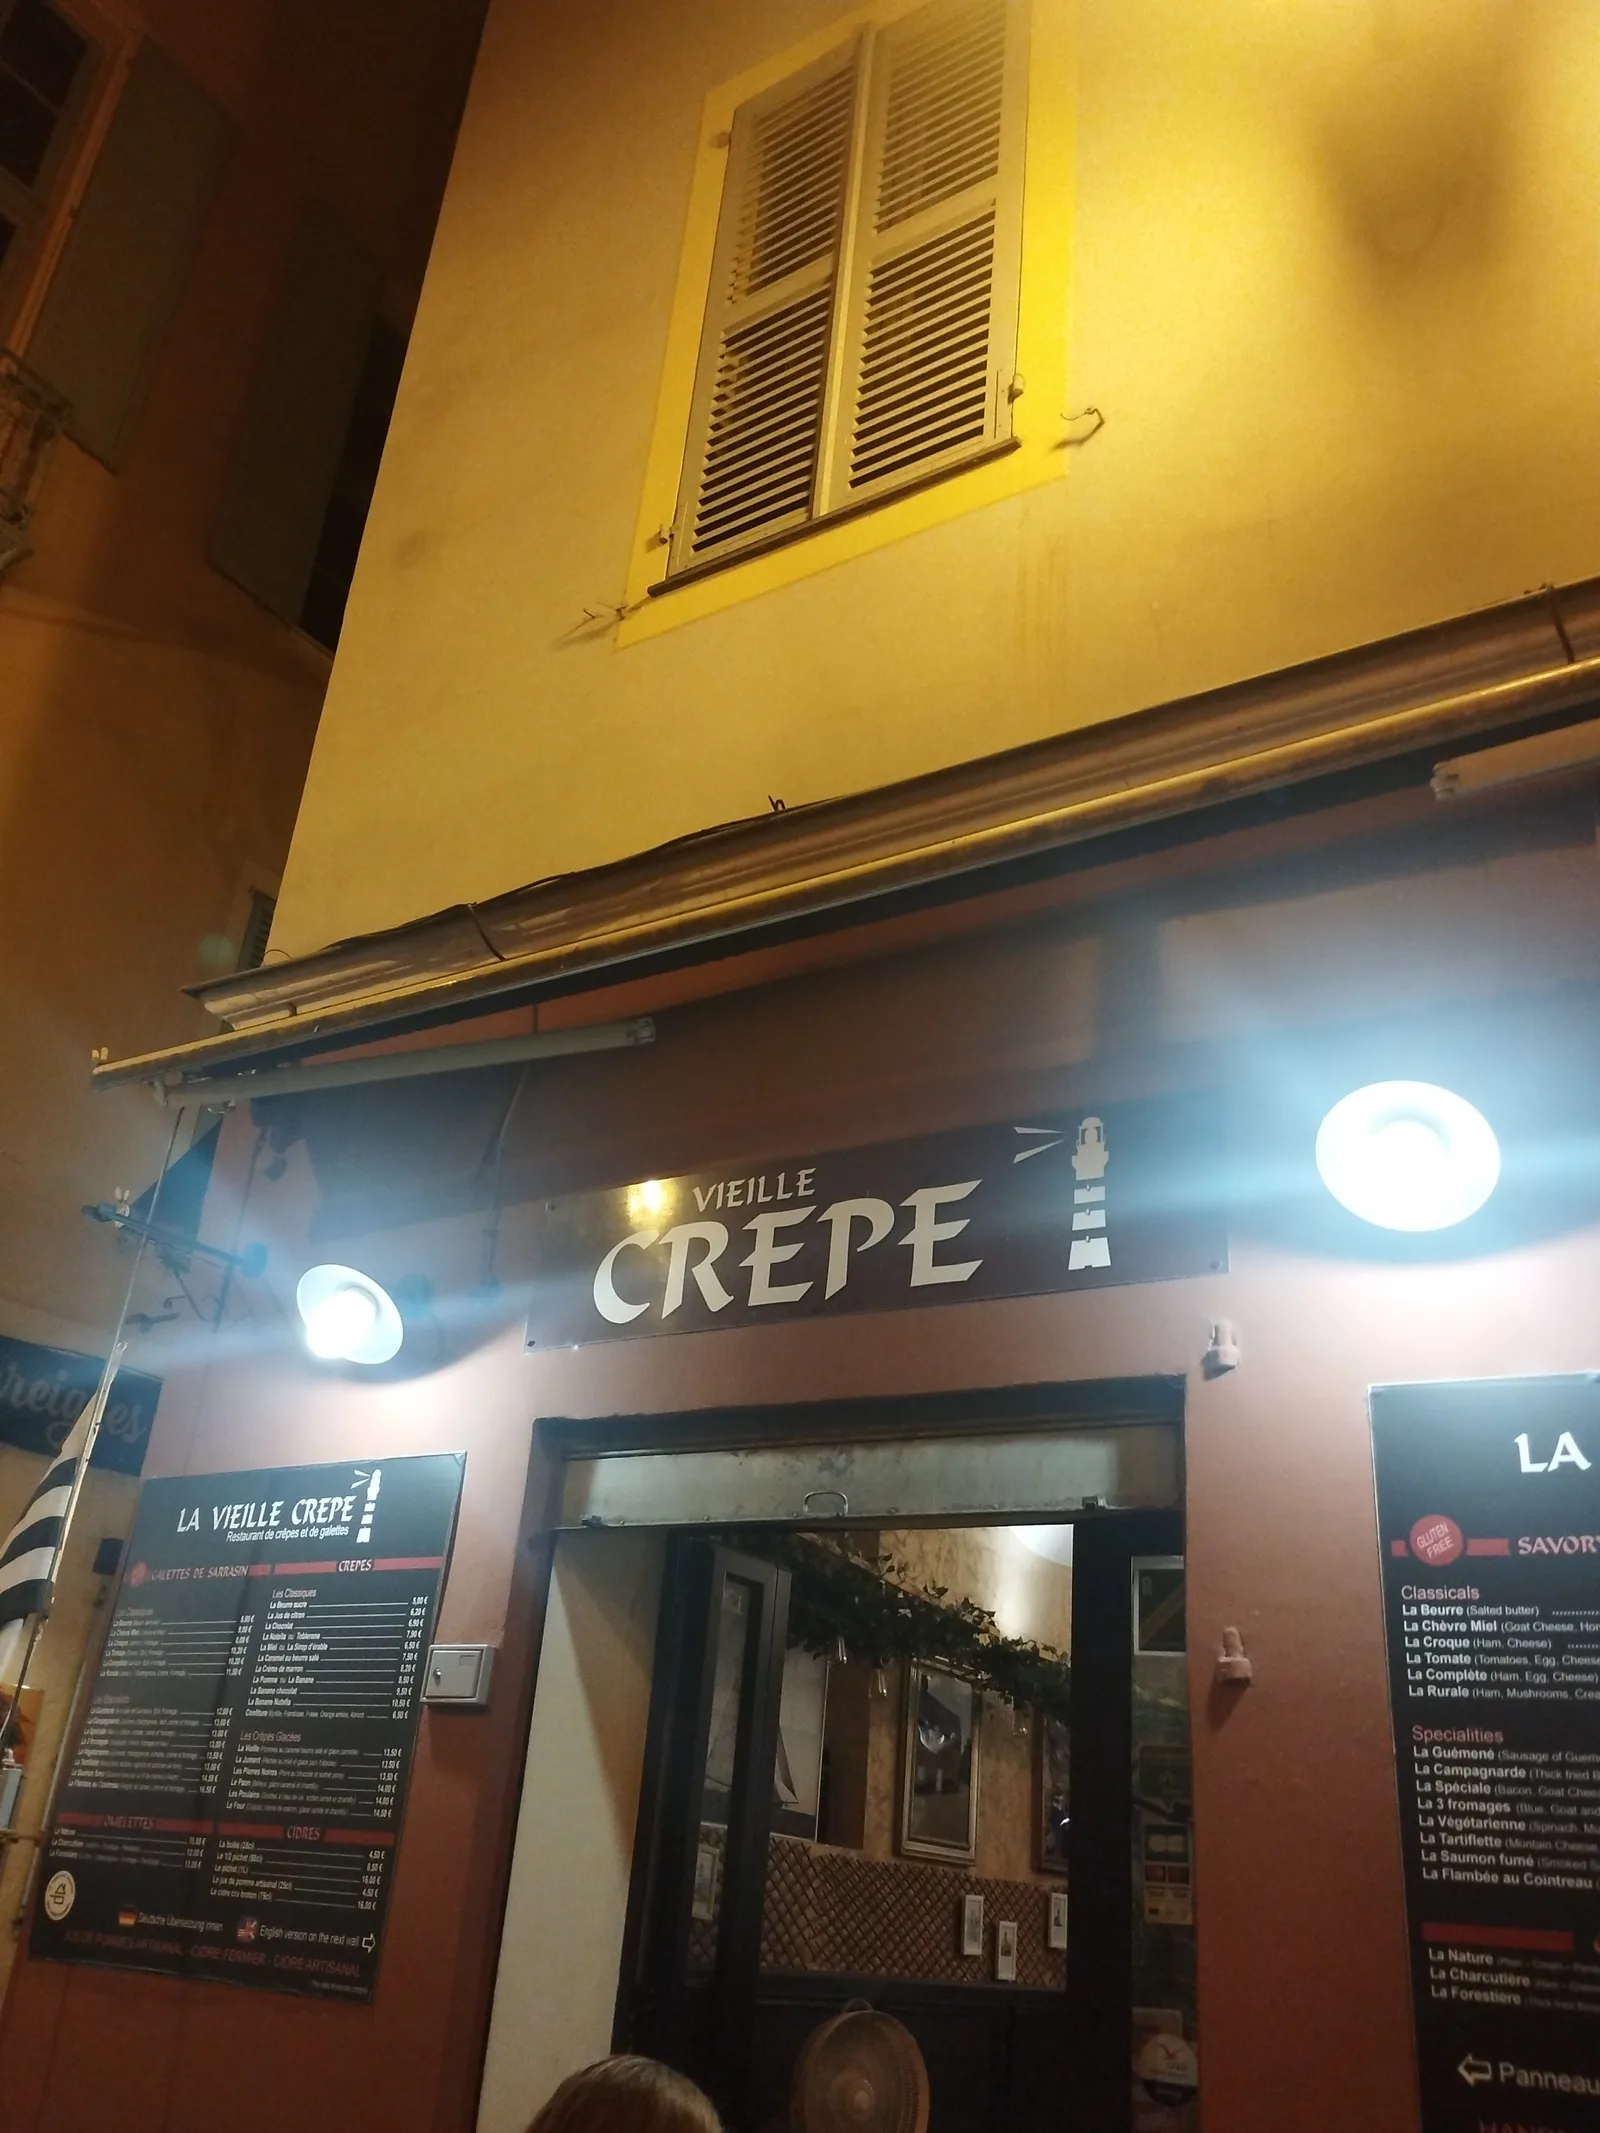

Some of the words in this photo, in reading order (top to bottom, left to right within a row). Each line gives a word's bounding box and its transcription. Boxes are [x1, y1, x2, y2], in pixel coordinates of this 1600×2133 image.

[693, 1168, 816, 1212] VIEILLE
[592, 1179, 984, 1325] CREPE
[1514, 1431, 1592, 1473] LA
[176, 1506, 200, 1533] LA
[212, 1500, 284, 1531] VIEILLE
[291, 1495, 357, 1525] CREPE
[226, 1530, 263, 1543] Restaurant
[264, 1529, 274, 1540] de
[275, 1528, 299, 1541] crêpes
[300, 1527, 308, 1538] et
[308, 1526, 318, 1537] de
[319, 1524, 349, 1539] galettes
[1416, 1521, 1449, 1549] GLUTEN
[1426, 1536, 1454, 1559] FREE
[151, 1567, 191, 1581] GALETTES
[192, 1567, 205, 1579] DE
[207, 1564, 250, 1578] SARRASIN
[338, 1558, 373, 1573] CREPES
[272, 1589, 283, 1599] Les
[284, 1588, 317, 1599] Classiques
[1401, 1585, 1480, 1601] Classicals
[270, 1601, 276, 1609] La
[1402, 1604, 1417, 1616] La
[1466, 1605, 1502, 1617] (Salted
[1505, 1605, 1540, 1617] butter)
[1403, 1620, 1419, 1632] La
[1470, 1620, 1498, 1632] Miel
[1500, 1621, 1531, 1633] (Goat
[1404, 1636, 1420, 1648] La
[1423, 1636, 1470, 1650] Croque
[1472, 1638, 1504, 1650] (Ham,
[1507, 1638, 1552, 1650] Cheese)
[1406, 1652, 1421, 1664] La
[1424, 1652, 1471, 1665] Tomate
[1407, 1668, 1422, 1680] La
[1408, 1684, 1424, 1697] La
[1427, 1684, 1470, 1697] Rurale
[240, 1730, 251, 1741] Les
[1412, 1725, 1504, 1744] Specialities
[1413, 1745, 1429, 1758] La
[1414, 1762, 1430, 1775] La
[1433, 1763, 1526, 1780] Campagnarde
[1416, 1780, 1432, 1792] La
[1435, 1780, 1491, 1795] Spéciale
[1417, 1797, 1433, 1810] La
[1436, 1797, 1444, 1810] 3
[1447, 1798, 1511, 1815] fromages
[1418, 1814, 1434, 1827] La
[286, 1825, 321, 1841] CIDRES
[1420, 1832, 1435, 1844] La
[1438, 1832, 1501, 1847] Tartiflette
[1421, 1849, 1436, 1862] La
[1440, 1850, 1496, 1864] Saumon
[1499, 1853, 1534, 1867] fumé
[1422, 1867, 1438, 1880] La
[1442, 1867, 1499, 1883] Flambée
[1503, 1874, 1519, 1885] au
[1523, 1872, 1592, 1889] Cointreau
[260, 1925, 283, 1940] English
[284, 1929, 307, 1941] version
[308, 1932, 317, 1942] on
[318, 1932, 329, 1944] the
[329, 1934, 345, 1945] next
[346, 1935, 360, 1947] wall
[1429, 1947, 1445, 1961] La
[1448, 1948, 1493, 1964] Nature
[1430, 1966, 1446, 1979] La
[1431, 1985, 1447, 1998] La
